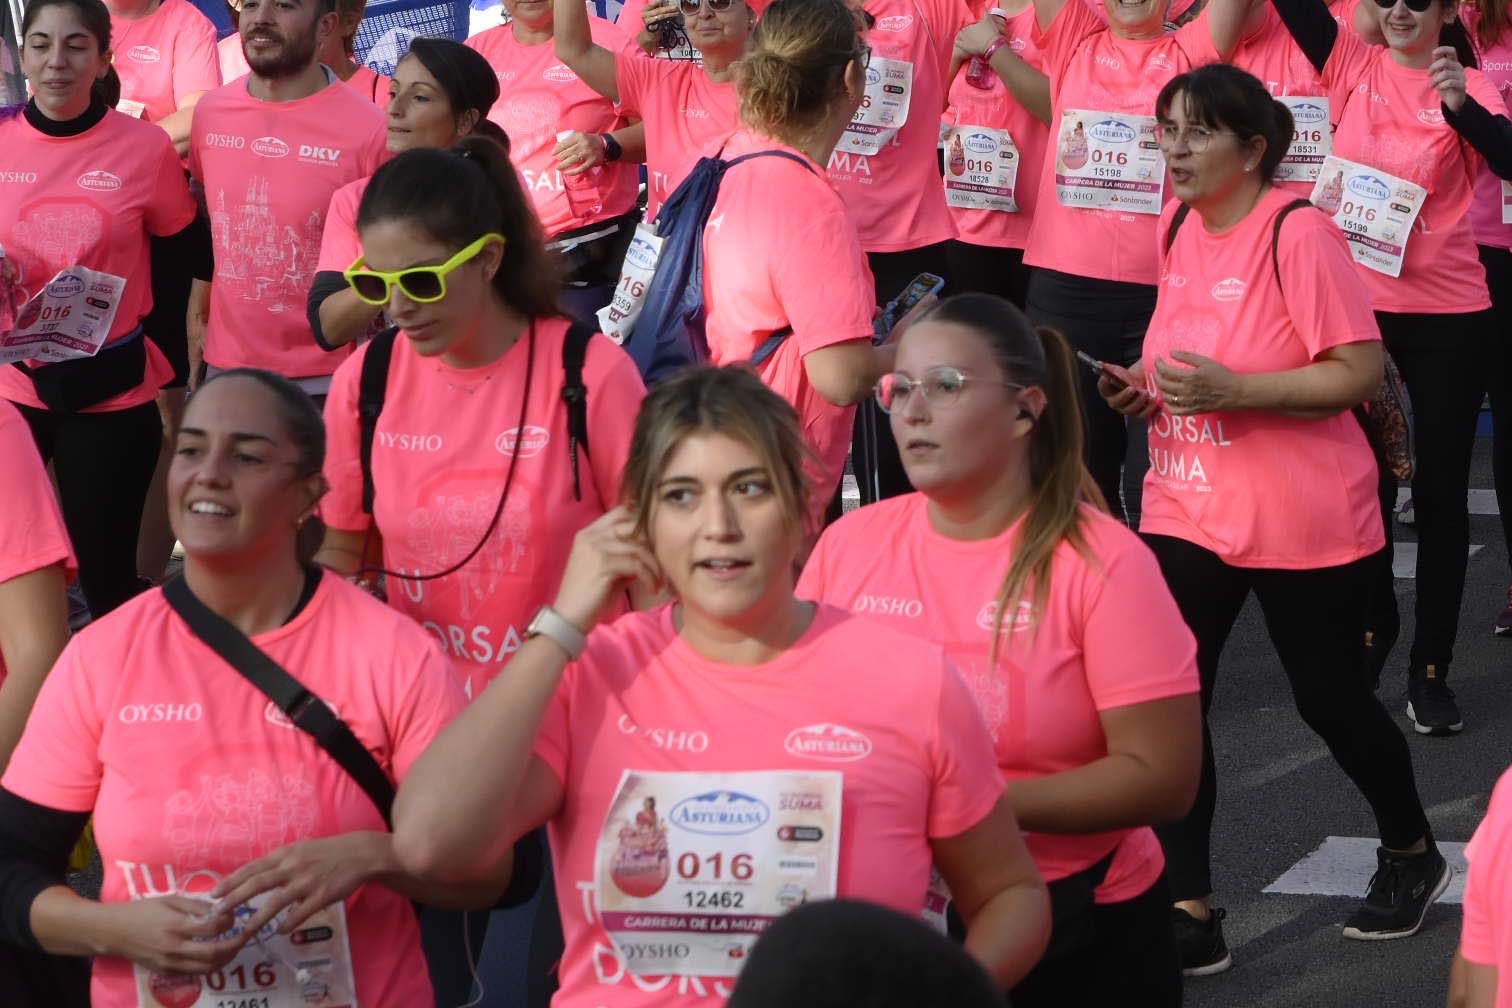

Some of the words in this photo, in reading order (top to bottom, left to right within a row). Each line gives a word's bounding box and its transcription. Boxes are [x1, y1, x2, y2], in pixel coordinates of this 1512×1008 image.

[205, 132, 246, 149] OYSHO
[1293, 145, 1318, 153] 18531
[298, 144, 342, 161] DKV
[1091, 148, 1128, 165] 016
[967, 159, 993, 173] 016
[1093, 167, 1122, 178] 15198
[969, 174, 989, 184] 18528
[1065, 178, 1094, 187] CARRERA
[1095, 179, 1104, 187] DE
[1105, 180, 1113, 188] LA
[1114, 181, 1136, 191] MUJER
[1060, 190, 1093, 201] OYSHO
[1119, 195, 1153, 206] Santander
[1342, 201, 1377, 222] 016
[1342, 219, 1368, 234] 15199
[1360, 236, 1379, 247] MUJER
[1363, 250, 1393, 267] Santander
[41, 305, 72, 321] 016
[1148, 413, 1232, 446] ORSAL
[118, 702, 203, 725] OYSHO
[791, 736, 866, 754] ASTURIANA
[678, 804, 763, 825] ASTURIANA
[677, 852, 755, 880] 016
[685, 891, 744, 909] 12462
[624, 916, 687, 929] CARRERA
[692, 917, 710, 929] DE
[713, 917, 728, 930] LA
[622, 942, 690, 959] OYSHO
[205, 962, 277, 991] 016
